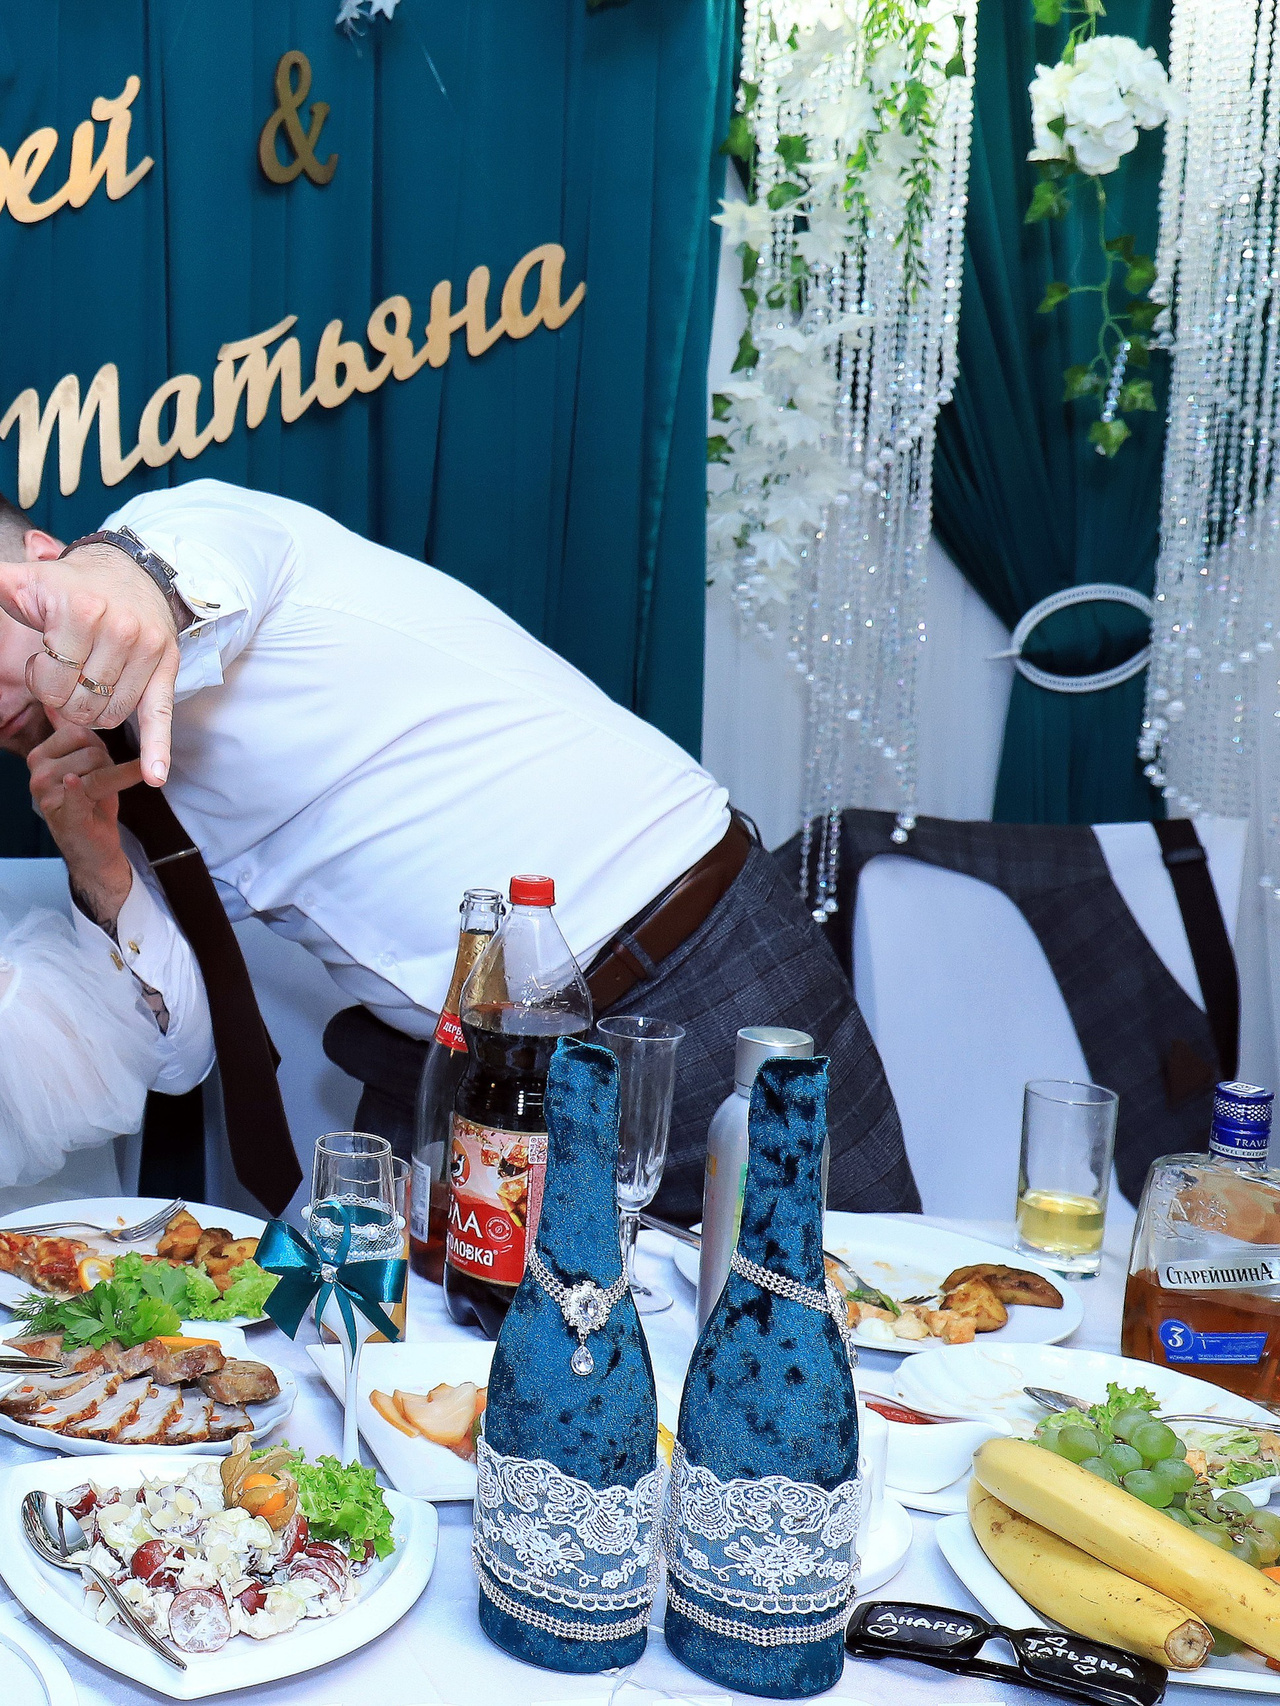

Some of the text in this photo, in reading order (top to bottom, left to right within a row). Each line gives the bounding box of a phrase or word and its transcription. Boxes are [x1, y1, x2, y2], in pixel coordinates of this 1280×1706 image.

[259, 50, 339, 185] &
[1167, 1326, 1184, 1348] 3
[1024, 1637, 1135, 1679] ТАТЬЯНА
